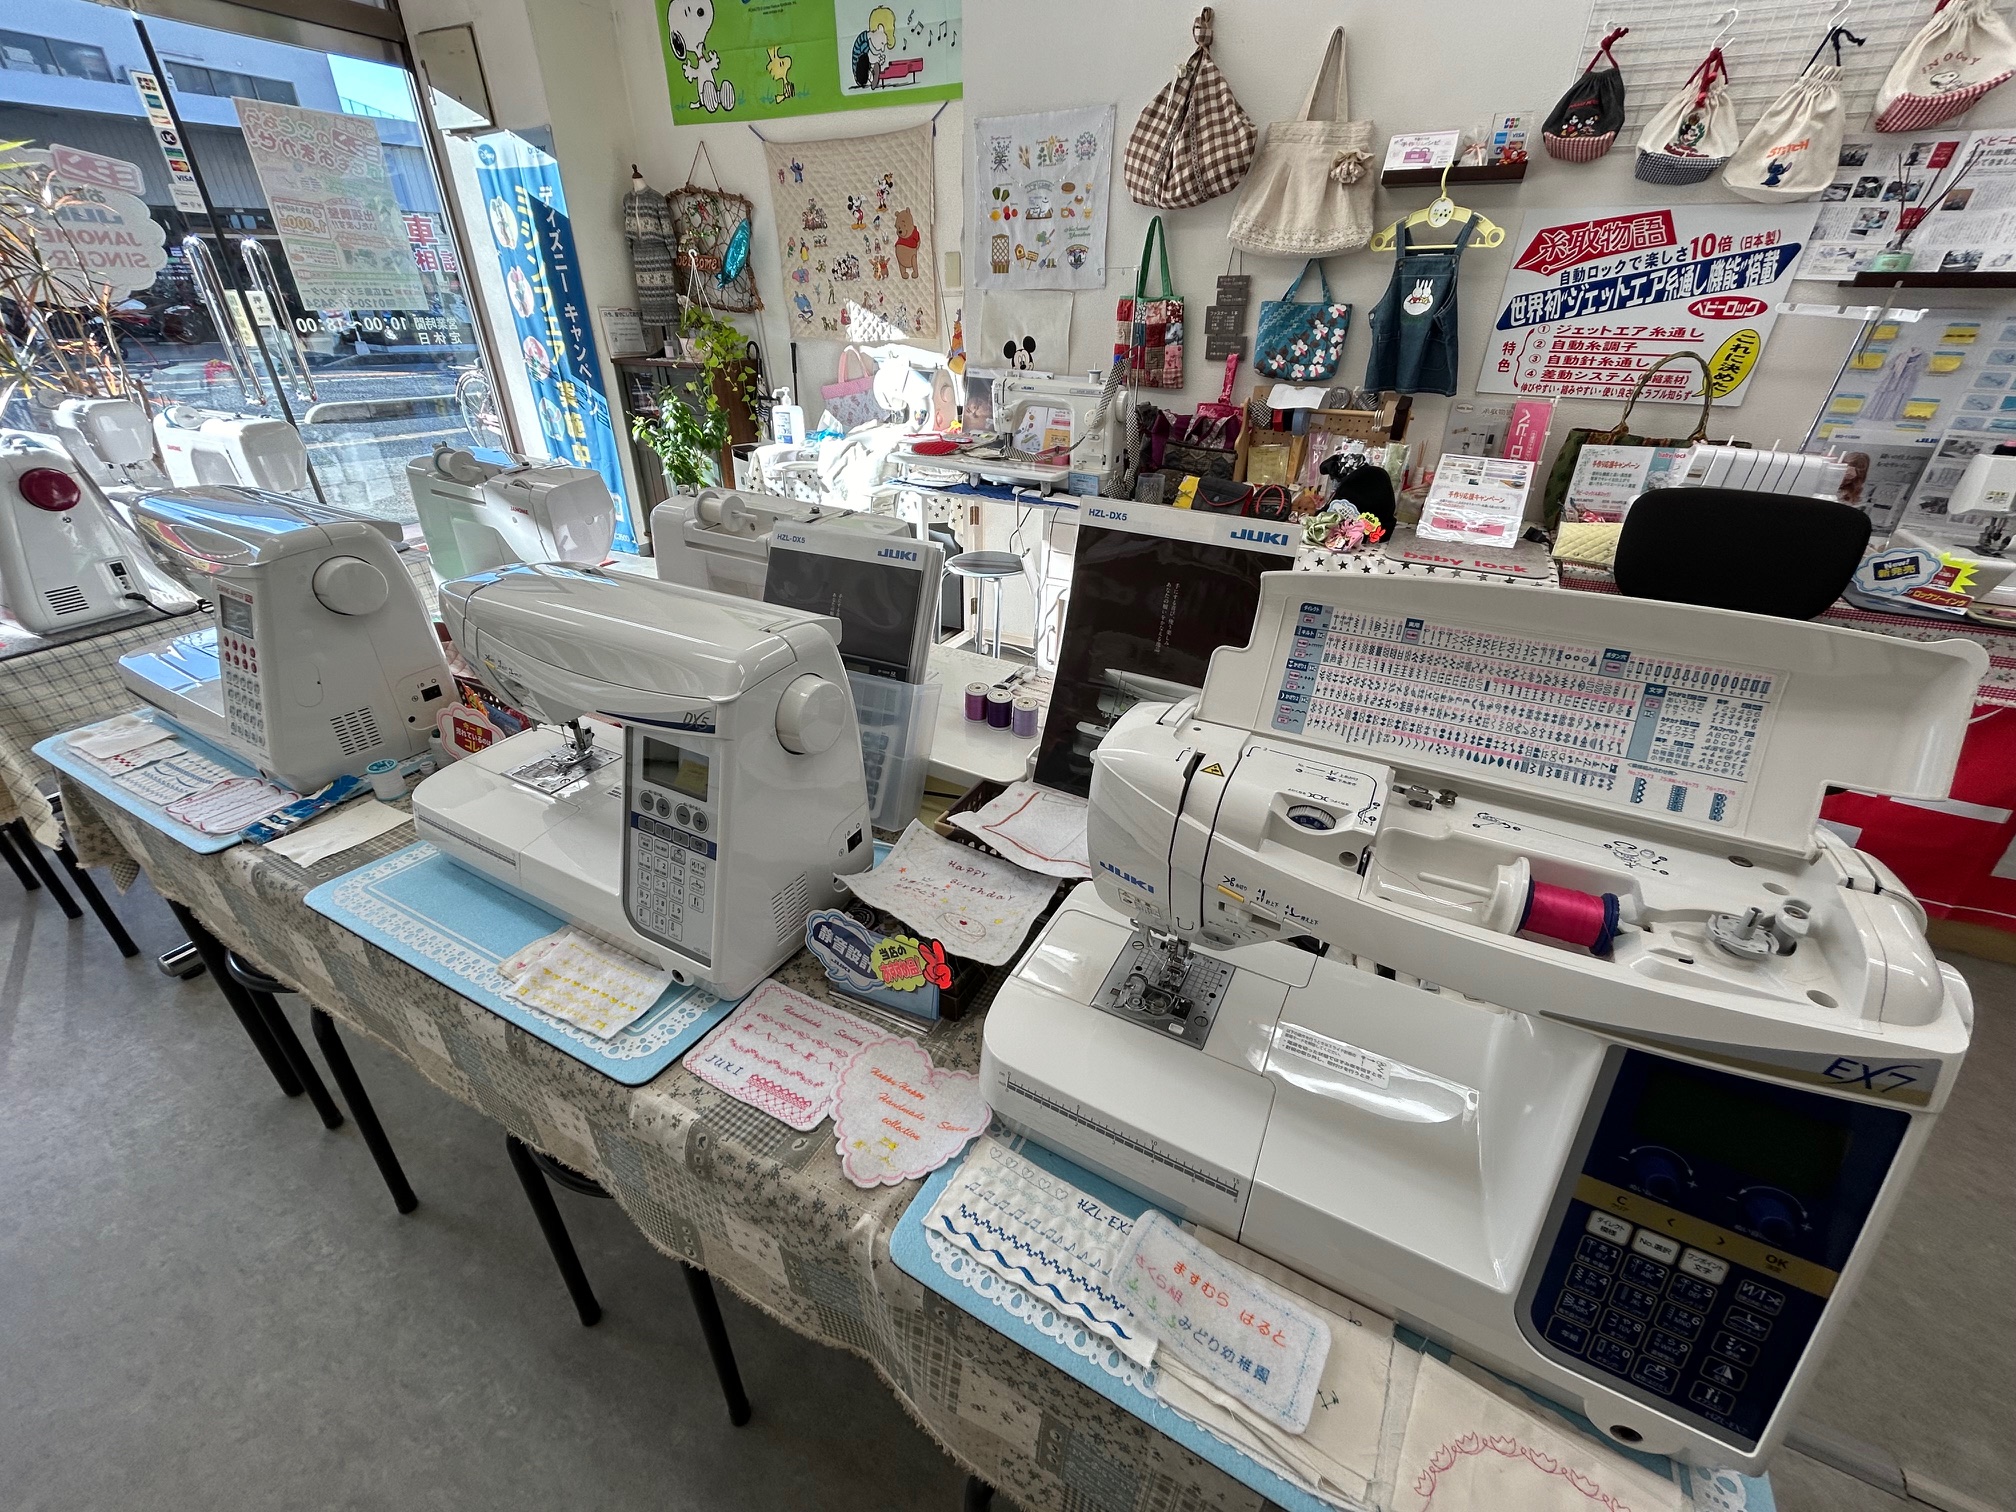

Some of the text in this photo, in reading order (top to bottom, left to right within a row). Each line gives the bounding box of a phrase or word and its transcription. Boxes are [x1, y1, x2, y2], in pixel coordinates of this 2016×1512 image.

[1504, 118, 1520, 128] JCB
[1517, 215, 1667, 275] 糸取物語
[538, 185, 599, 416] ディズニー キャンペーン
[1692, 299, 1763, 318] ベビーロック
[1551, 340, 1638, 353] 自動糸調子
[1497, 341, 1516, 374] 特色
[1547, 353, 1651, 368] 自動針糸通し
[1712, 331, 1760, 392] これに決めた
[1510, 408, 1531, 460] ベビーロ
[1448, 490, 1505, 503] 手作り応援キャンペーン
[1088, 507, 1128, 522] HZL-DX5
[777, 533, 806, 544] HZL-DX5
[1230, 527, 1288, 547] JUKI
[877, 548, 918, 562] JUKI
[1403, 551, 1529, 573] baby lock
[1877, 564, 1916, 578] 新発売
[1884, 558, 1911, 569] New!
[683, 709, 712, 730] DX5
[1099, 860, 1156, 894] JUKI
[818, 924, 872, 973] 静音設計
[879, 944, 907, 960] 当店の
[783, 1004, 823, 1029] Handmade
[704, 1053, 745, 1077] JUKI
[1822, 1057, 1924, 1095] EX7
[878, 1092, 926, 1122] Handmade
[1616, 1195, 1628, 1205] C
[1596, 1216, 1625, 1232] ダイレクト
[1610, 1247, 1618, 1258] 1
[1687, 1252, 1725, 1272] ワンポイント
[1764, 1253, 1790, 1270] OK
[1134, 1253, 1184, 1306] さくら組
[1599, 1276, 1608, 1286] 4
[1656, 1268, 1665, 1279] 2
[1643, 1296, 1653, 1306] 5
[1703, 1288, 1714, 1298] 3
[1173, 1259, 1288, 1349] ますむら はると
[1588, 1304, 1598, 1312] 7
[1632, 1323, 1642, 1332] 8
[1691, 1316, 1700, 1326] 6
[1178, 1314, 1271, 1385] みどり幼稚園
[1621, 1350, 1631, 1359] 0
[1679, 1344, 1688, 1353] 9
